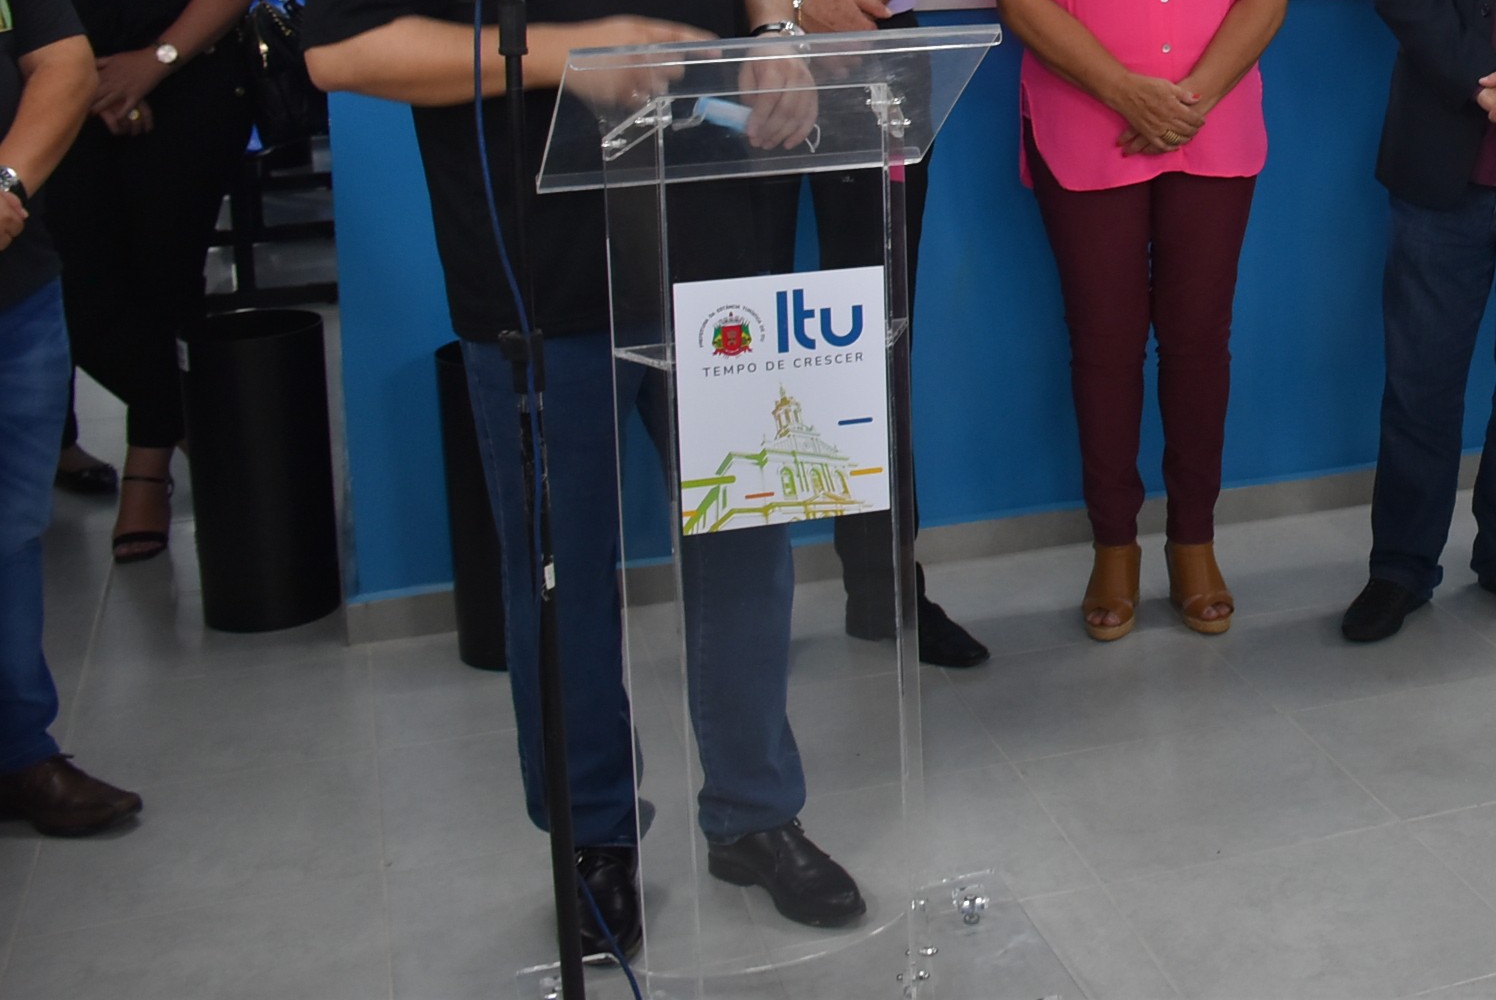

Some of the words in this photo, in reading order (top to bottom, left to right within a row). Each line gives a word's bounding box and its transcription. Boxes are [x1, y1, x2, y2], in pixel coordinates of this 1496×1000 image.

[775, 287, 864, 354] Itu
[702, 362, 758, 378] TEMPO
[765, 358, 786, 372] DE
[792, 351, 864, 369] CRESCER
